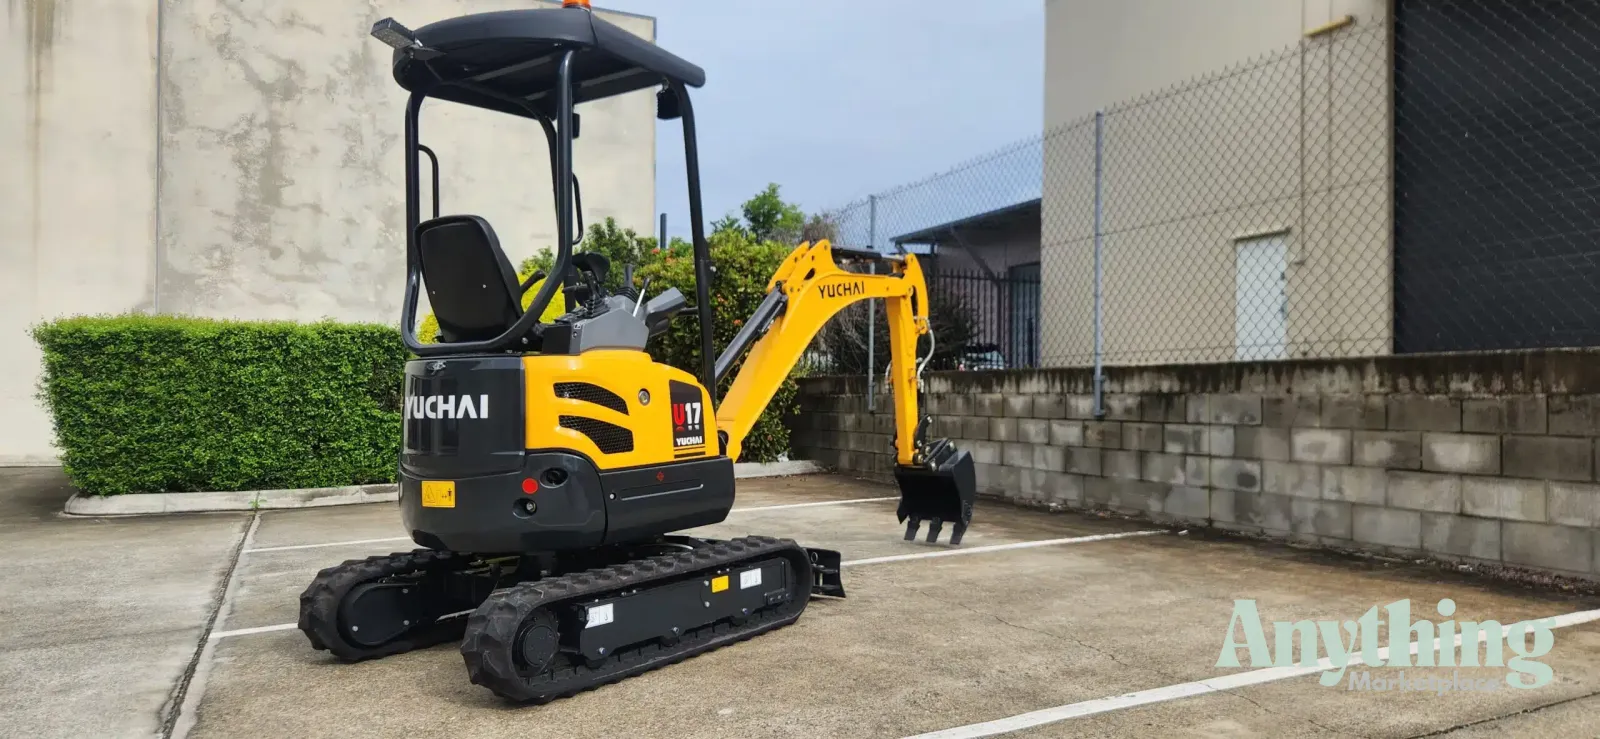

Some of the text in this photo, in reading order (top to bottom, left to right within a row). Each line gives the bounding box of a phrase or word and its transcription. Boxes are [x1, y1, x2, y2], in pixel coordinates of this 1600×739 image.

[818, 281, 864, 299] YUCHAI
[405, 394, 489, 419] YUCHAI
[673, 402, 701, 426] U17
[676, 436, 703, 446] YUCHAI
